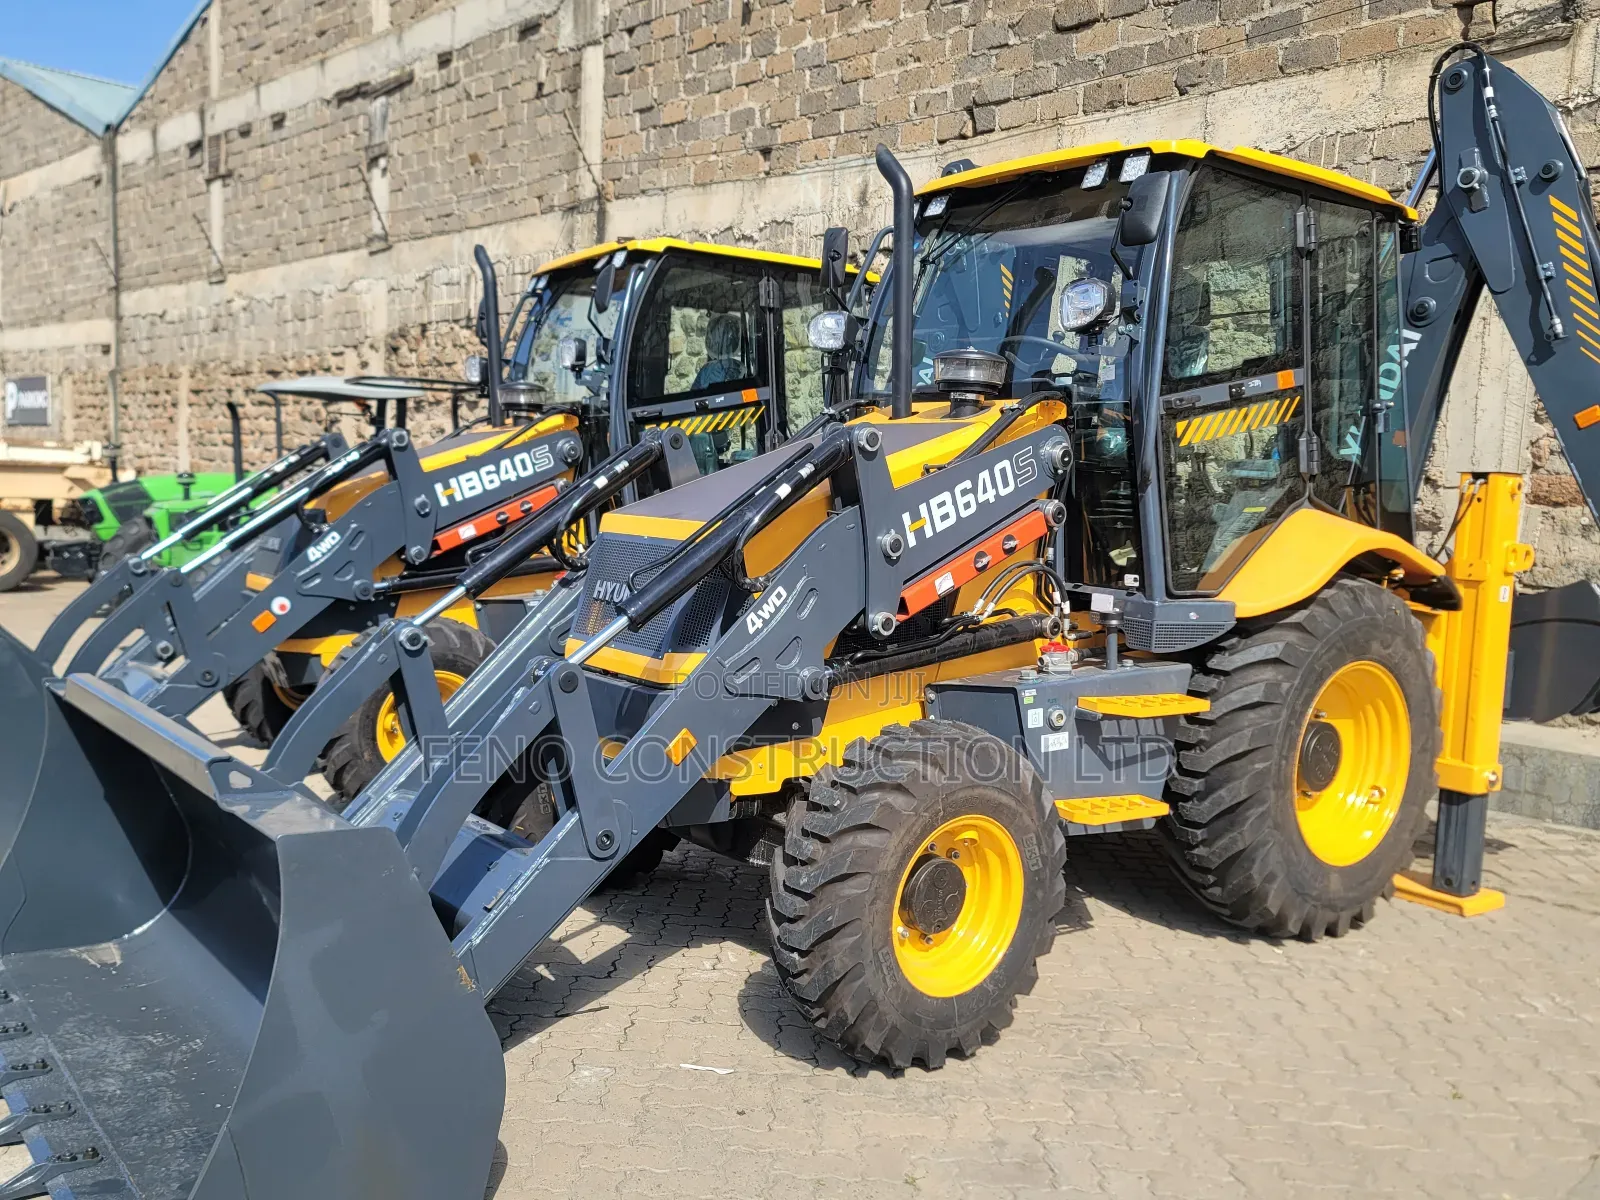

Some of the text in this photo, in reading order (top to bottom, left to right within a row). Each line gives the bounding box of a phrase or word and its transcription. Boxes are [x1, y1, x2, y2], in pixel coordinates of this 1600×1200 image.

[434, 444, 554, 507] HB640S
[902, 445, 1038, 548] HB640S
[307, 531, 341, 562] 4WD
[746, 585, 787, 635] 4WD
[1022, 832, 1043, 871] BKT
